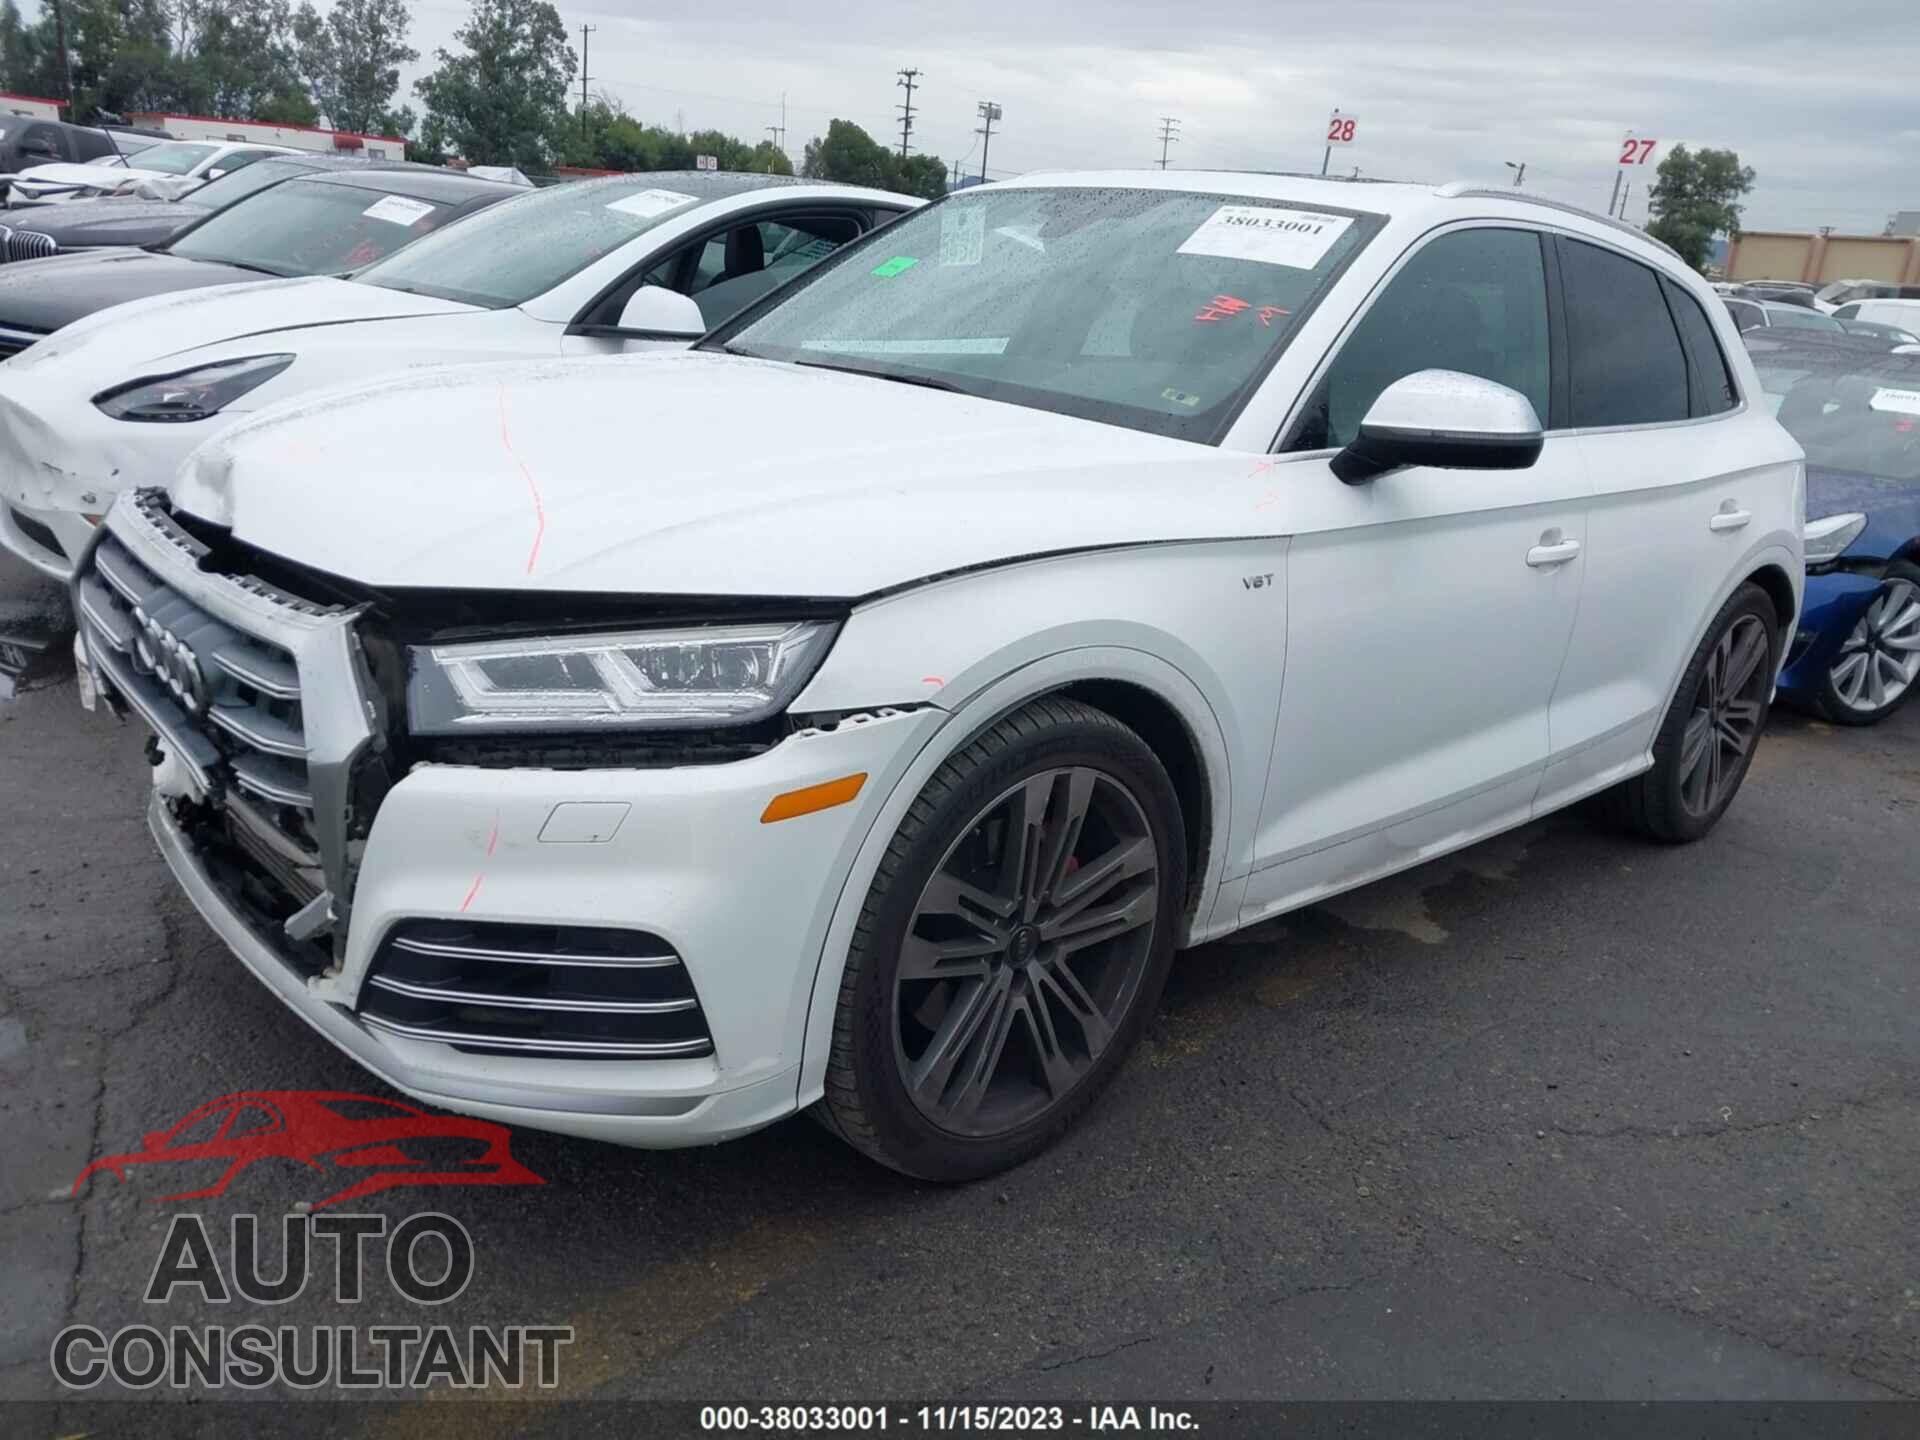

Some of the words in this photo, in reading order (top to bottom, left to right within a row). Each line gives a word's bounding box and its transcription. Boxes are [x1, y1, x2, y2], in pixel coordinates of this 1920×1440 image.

[1327, 118, 1355, 142] 28
[1619, 139, 1656, 165] 27
[1219, 215, 1323, 235] 38033001
